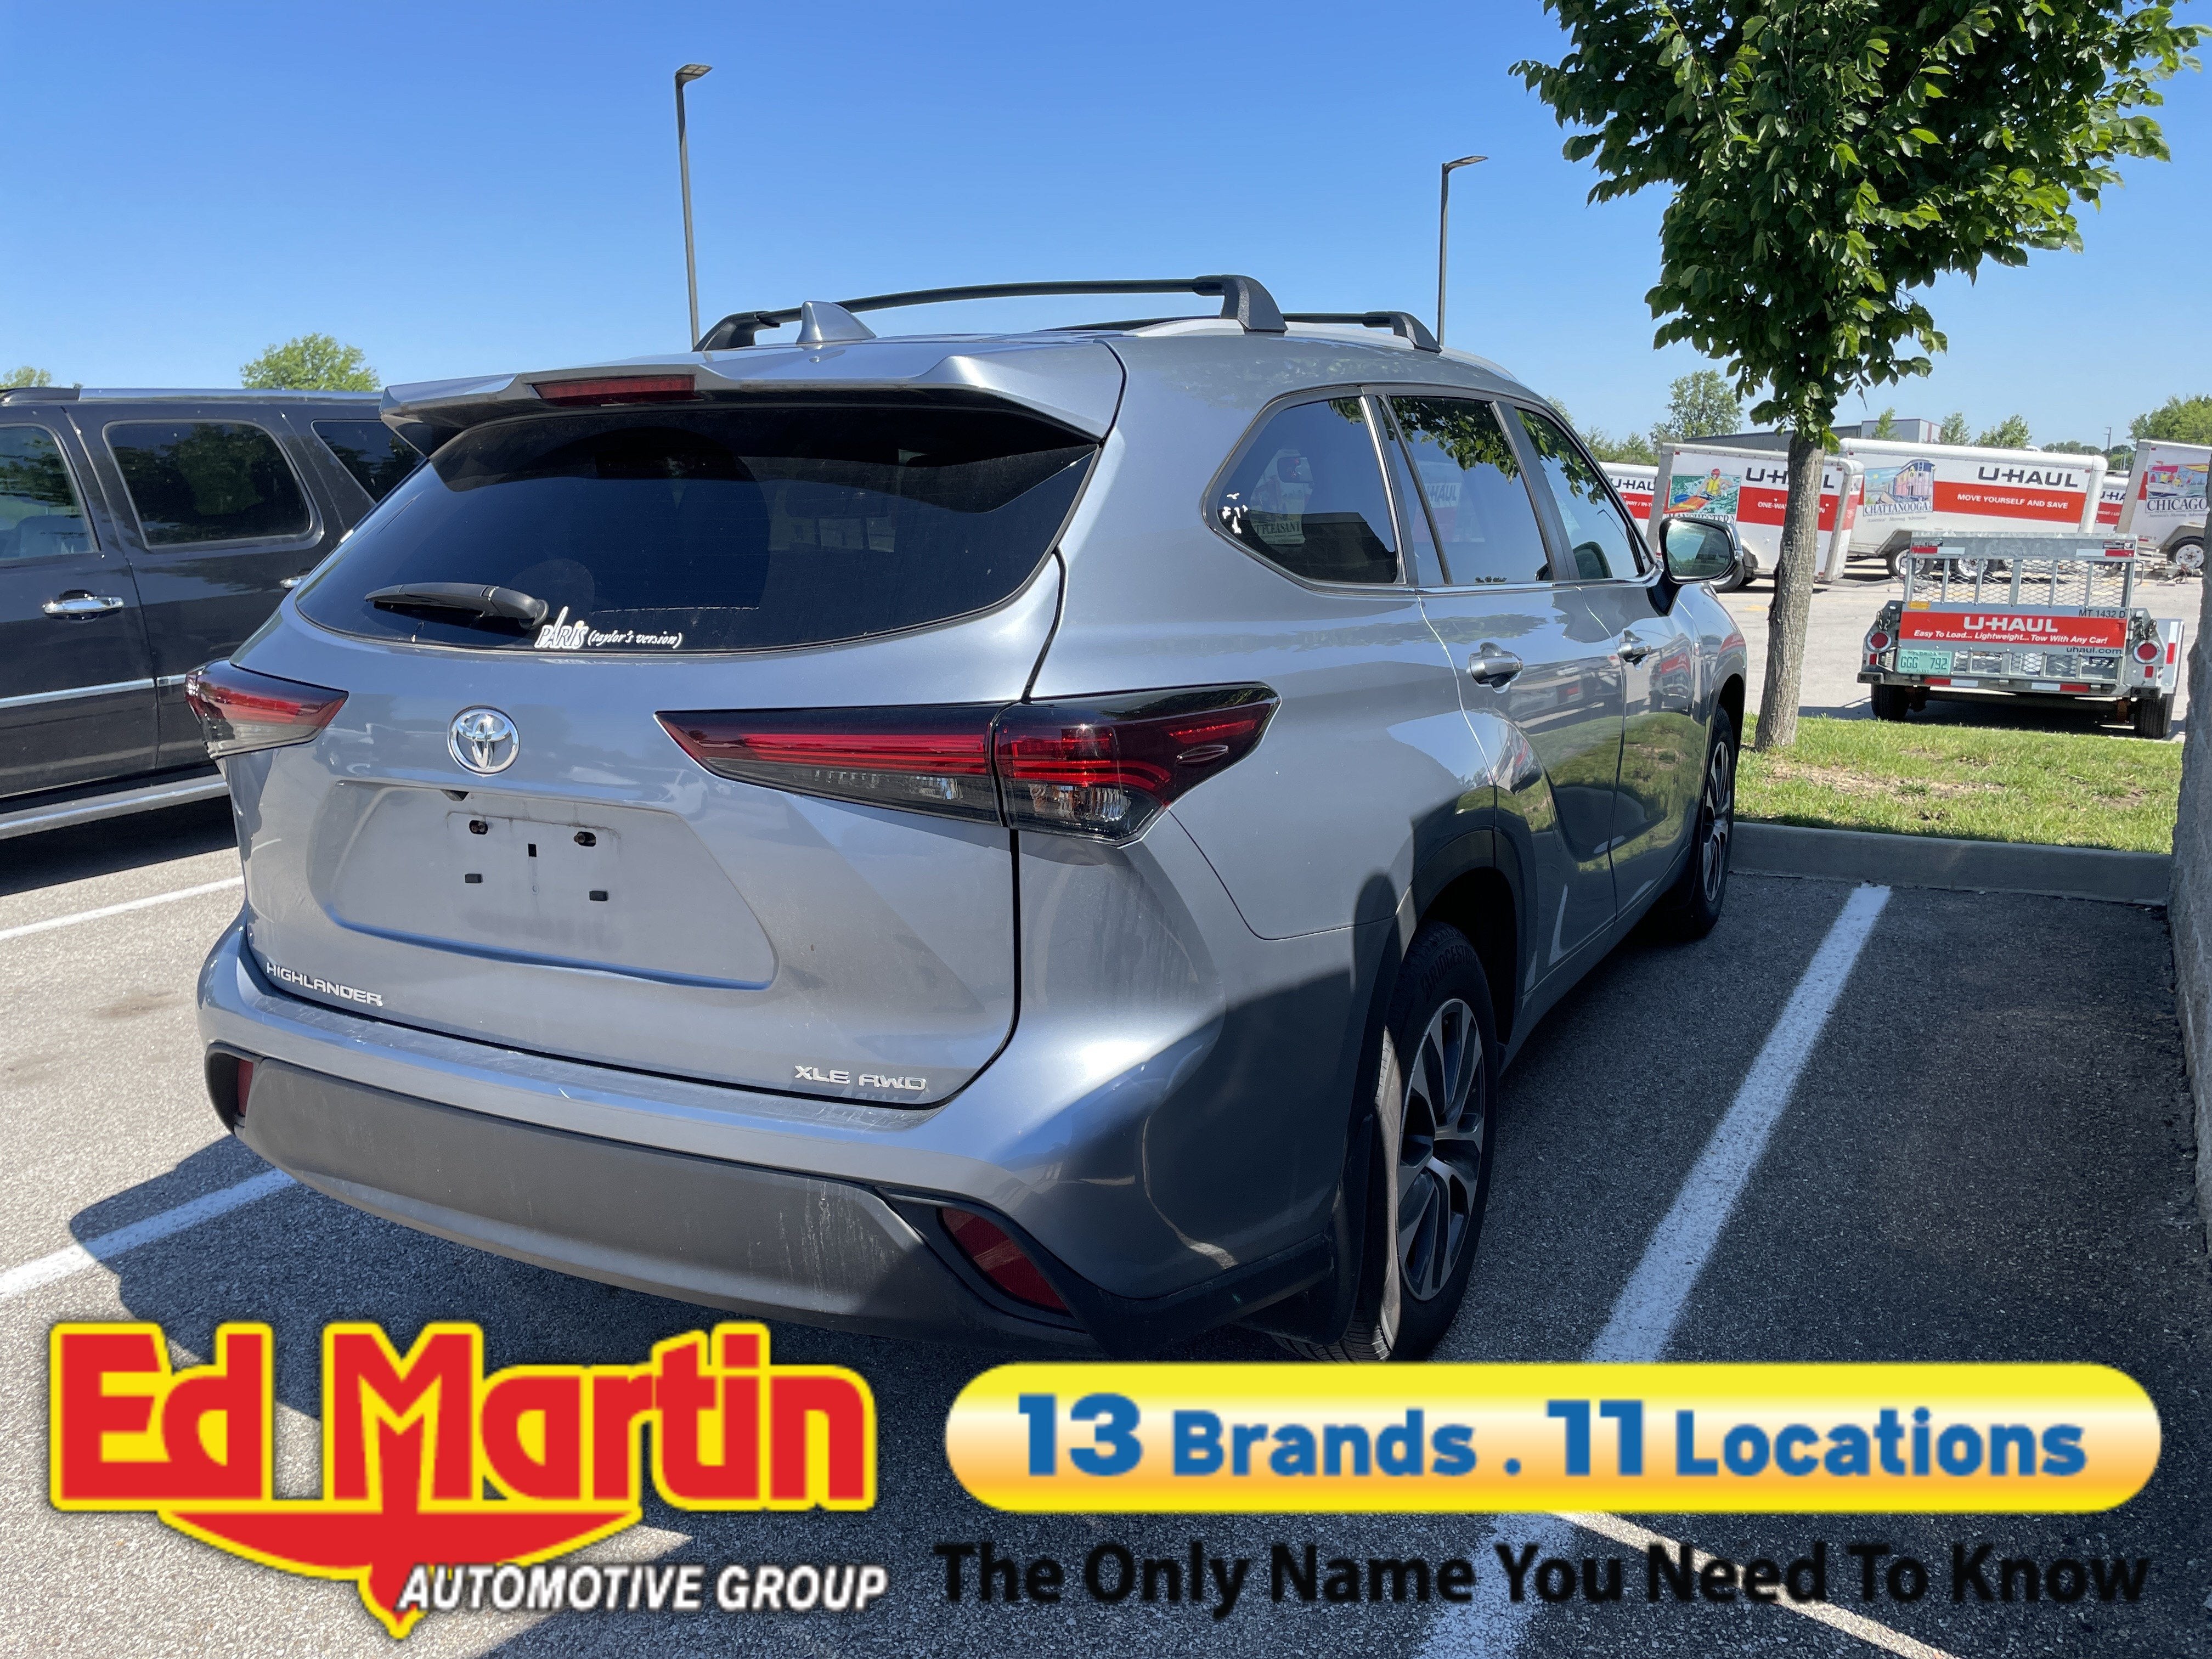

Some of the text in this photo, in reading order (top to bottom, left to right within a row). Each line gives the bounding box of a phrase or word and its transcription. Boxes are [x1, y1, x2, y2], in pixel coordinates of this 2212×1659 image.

[1610, 477, 1656, 491] U-HAU
[1746, 467, 1834, 489] U-HL
[1978, 466, 2078, 488] U-HAUL
[1757, 501, 1787, 510] ONE-WA
[1865, 502, 1928, 515] CHATTANOOGA
[1957, 494, 2069, 509] MOVE YOURSELF AND SAVE
[2147, 498, 2208, 511] CHICAGO
[2079, 609, 2094, 617] MT
[534, 606, 589, 650] PARIS
[1963, 616, 2058, 633] U-HAUL
[1914, 629, 1934, 639] Easy
[1974, 632, 2030, 642] Lightweight...
[2070, 636, 2087, 645] Any
[1931, 657, 1948, 670] 792
[266, 962, 383, 1007] HIGHLANDER
[794, 1065, 927, 1090] XLE AWD
